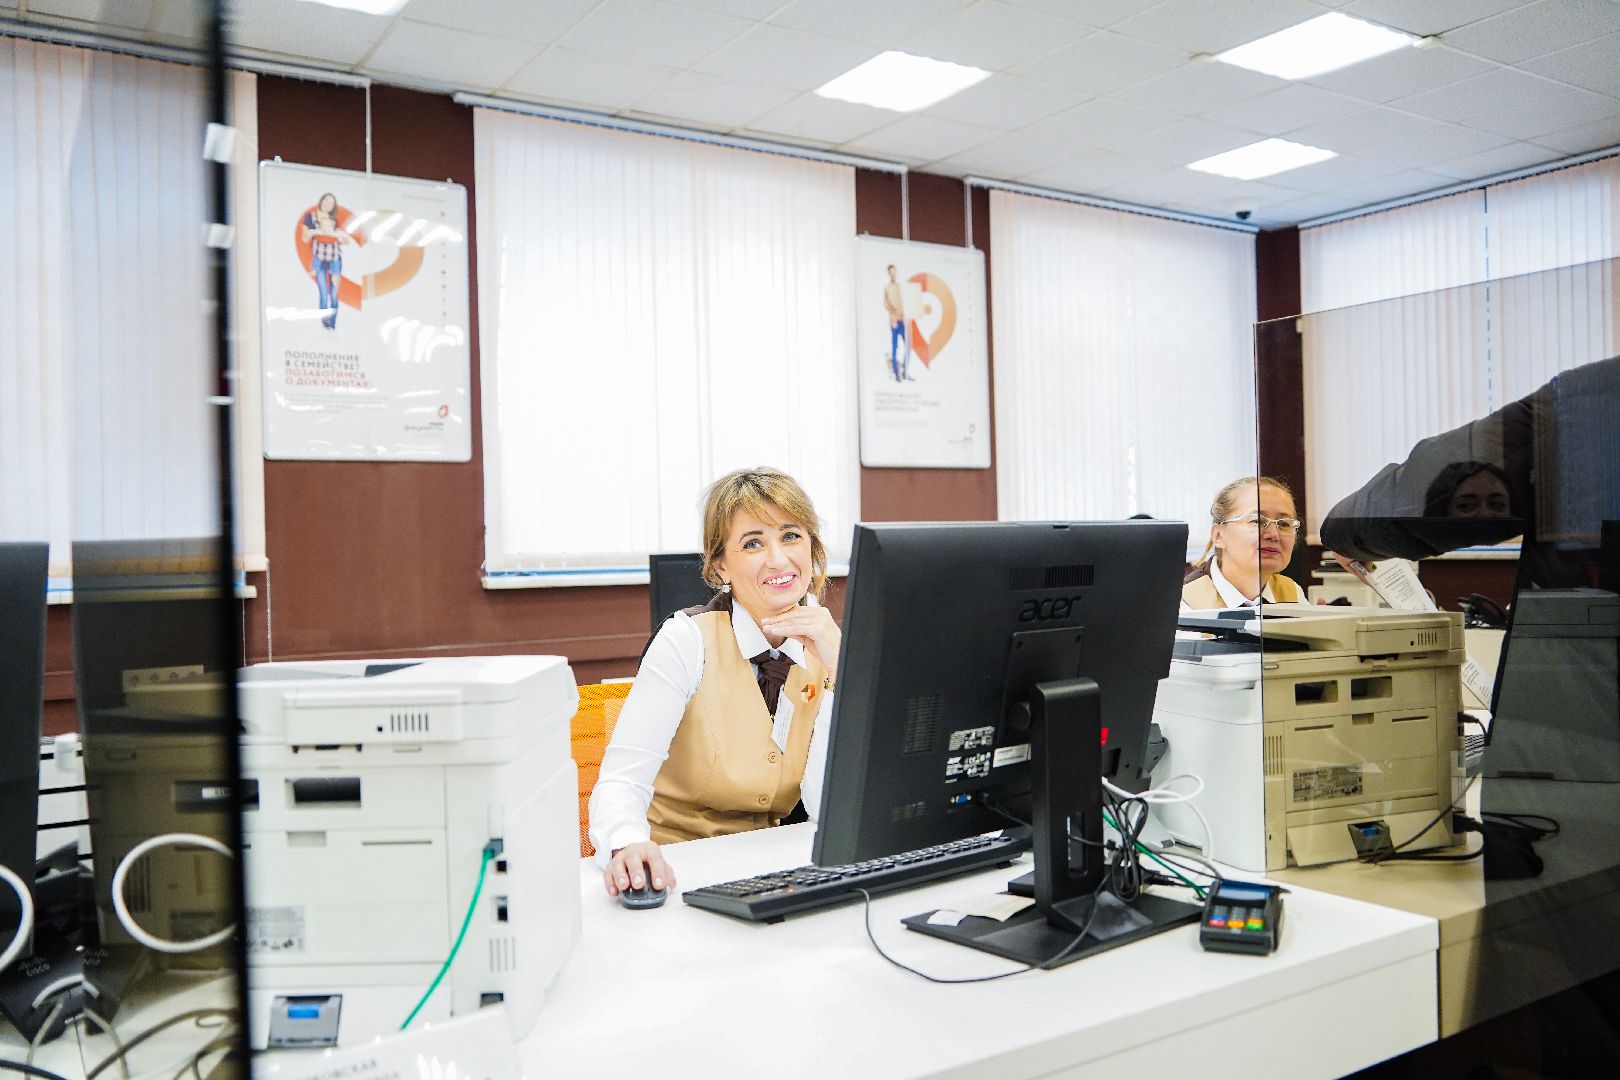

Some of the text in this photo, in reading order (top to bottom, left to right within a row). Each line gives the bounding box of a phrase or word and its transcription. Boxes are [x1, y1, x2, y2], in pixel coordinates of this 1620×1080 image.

[285, 350, 359, 361] ПОПОЛНЕНИЕ
[285, 368, 366, 379] ПОЗАБОТИМСЯ
[285, 377, 293, 385] О
[1019, 596, 1082, 621] acer
